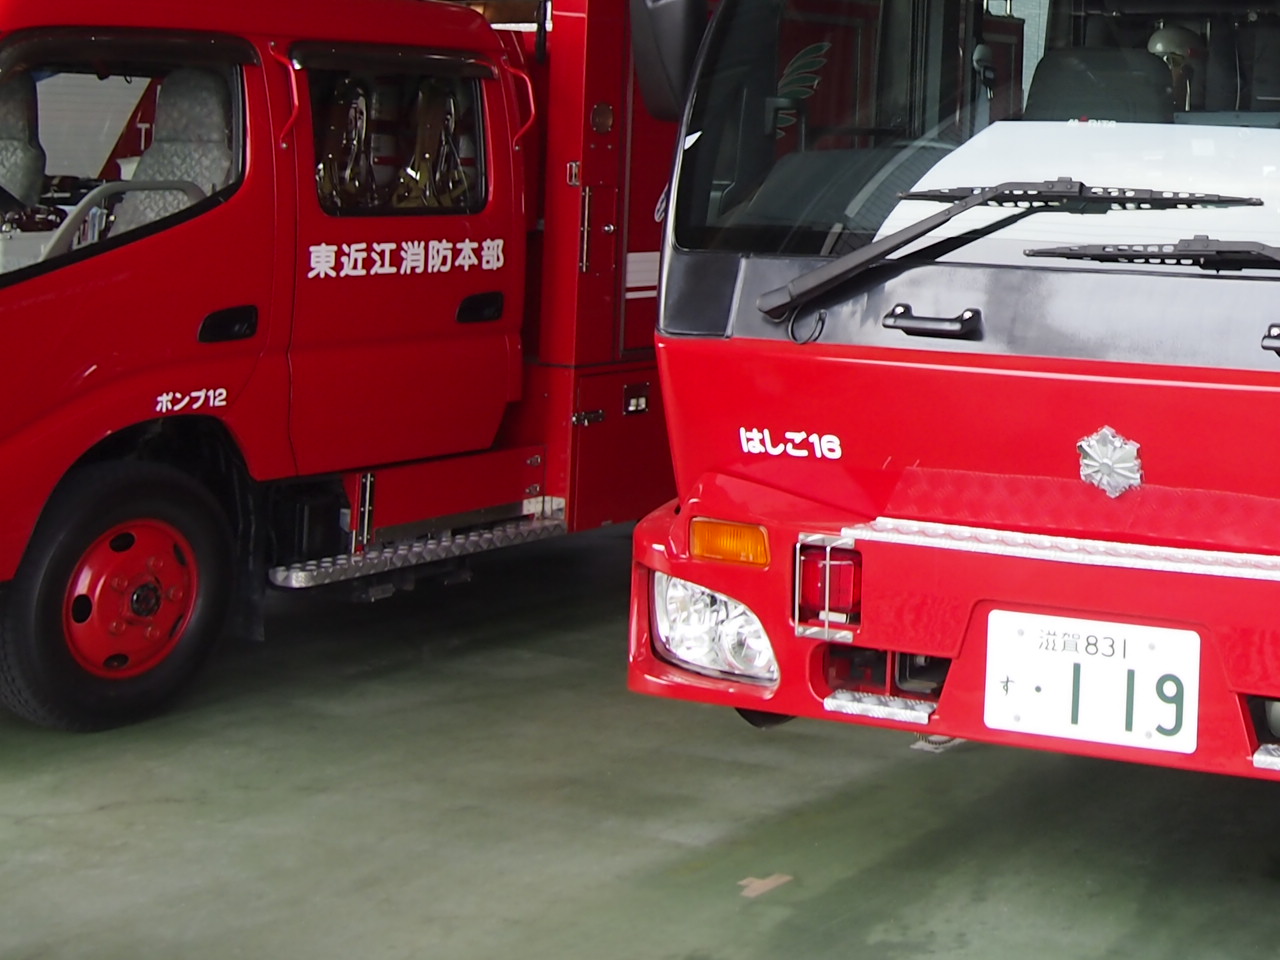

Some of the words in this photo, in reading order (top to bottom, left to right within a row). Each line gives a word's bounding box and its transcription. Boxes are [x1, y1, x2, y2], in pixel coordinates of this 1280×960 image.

[307, 237, 505, 279] 東近江消防本部
[156, 388, 227, 413] ポンプ12
[739, 427, 842, 460] はしご16
